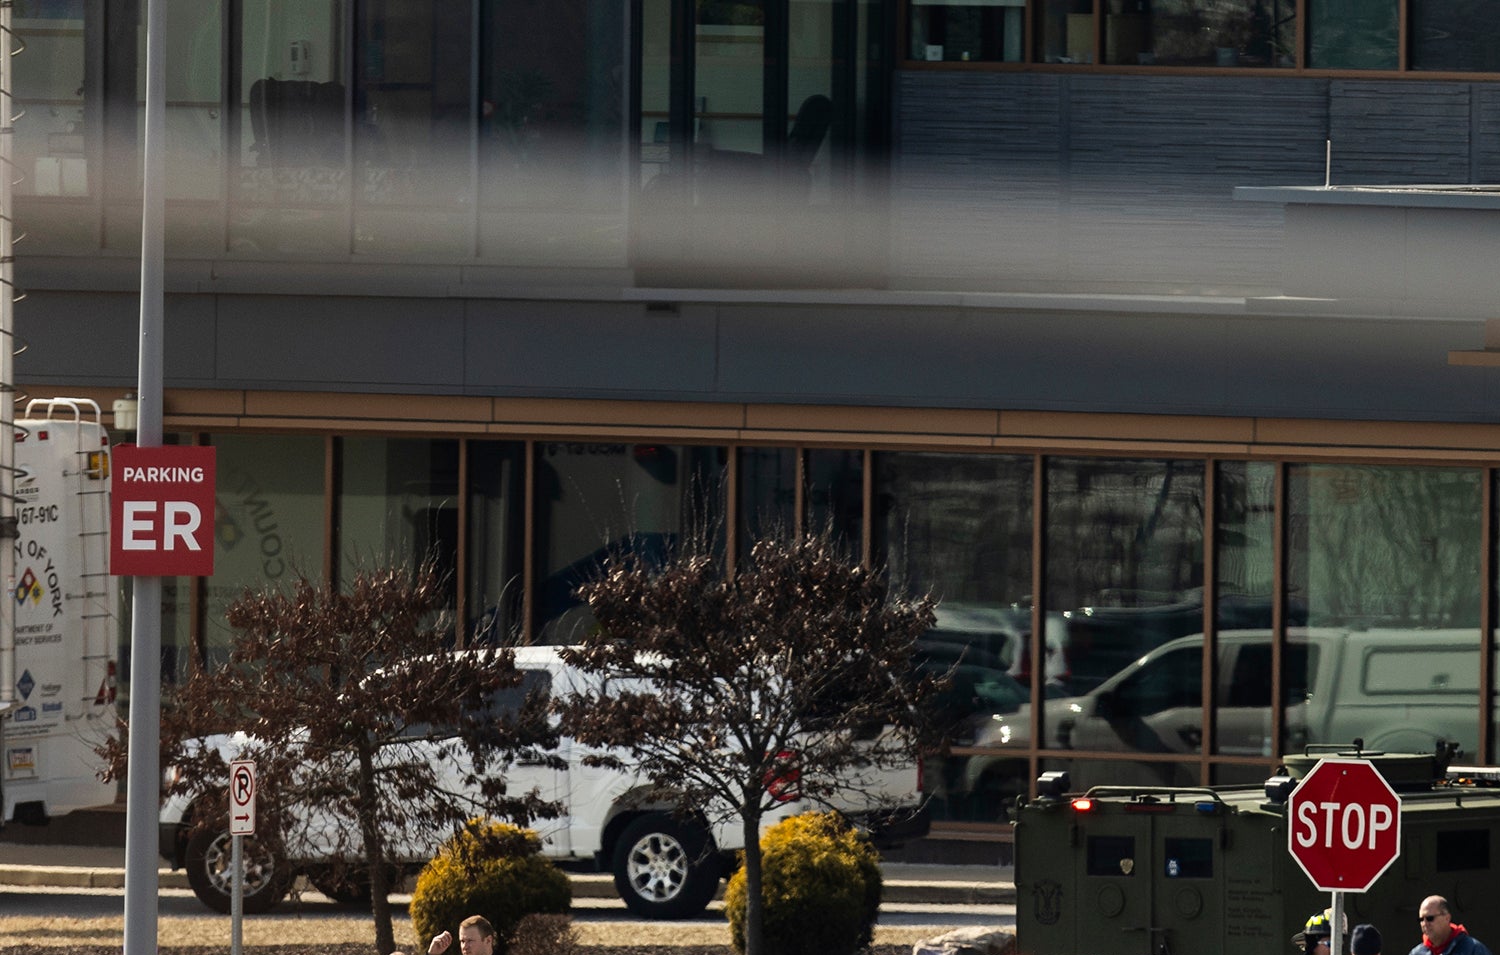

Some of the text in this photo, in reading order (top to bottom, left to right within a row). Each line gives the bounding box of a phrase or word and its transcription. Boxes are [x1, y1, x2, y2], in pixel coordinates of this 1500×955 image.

[123, 467, 204, 483] PARKING
[122, 501, 202, 551] ER
[27, 539, 63, 618] OF YORK
[1296, 800, 1393, 850] STOP
